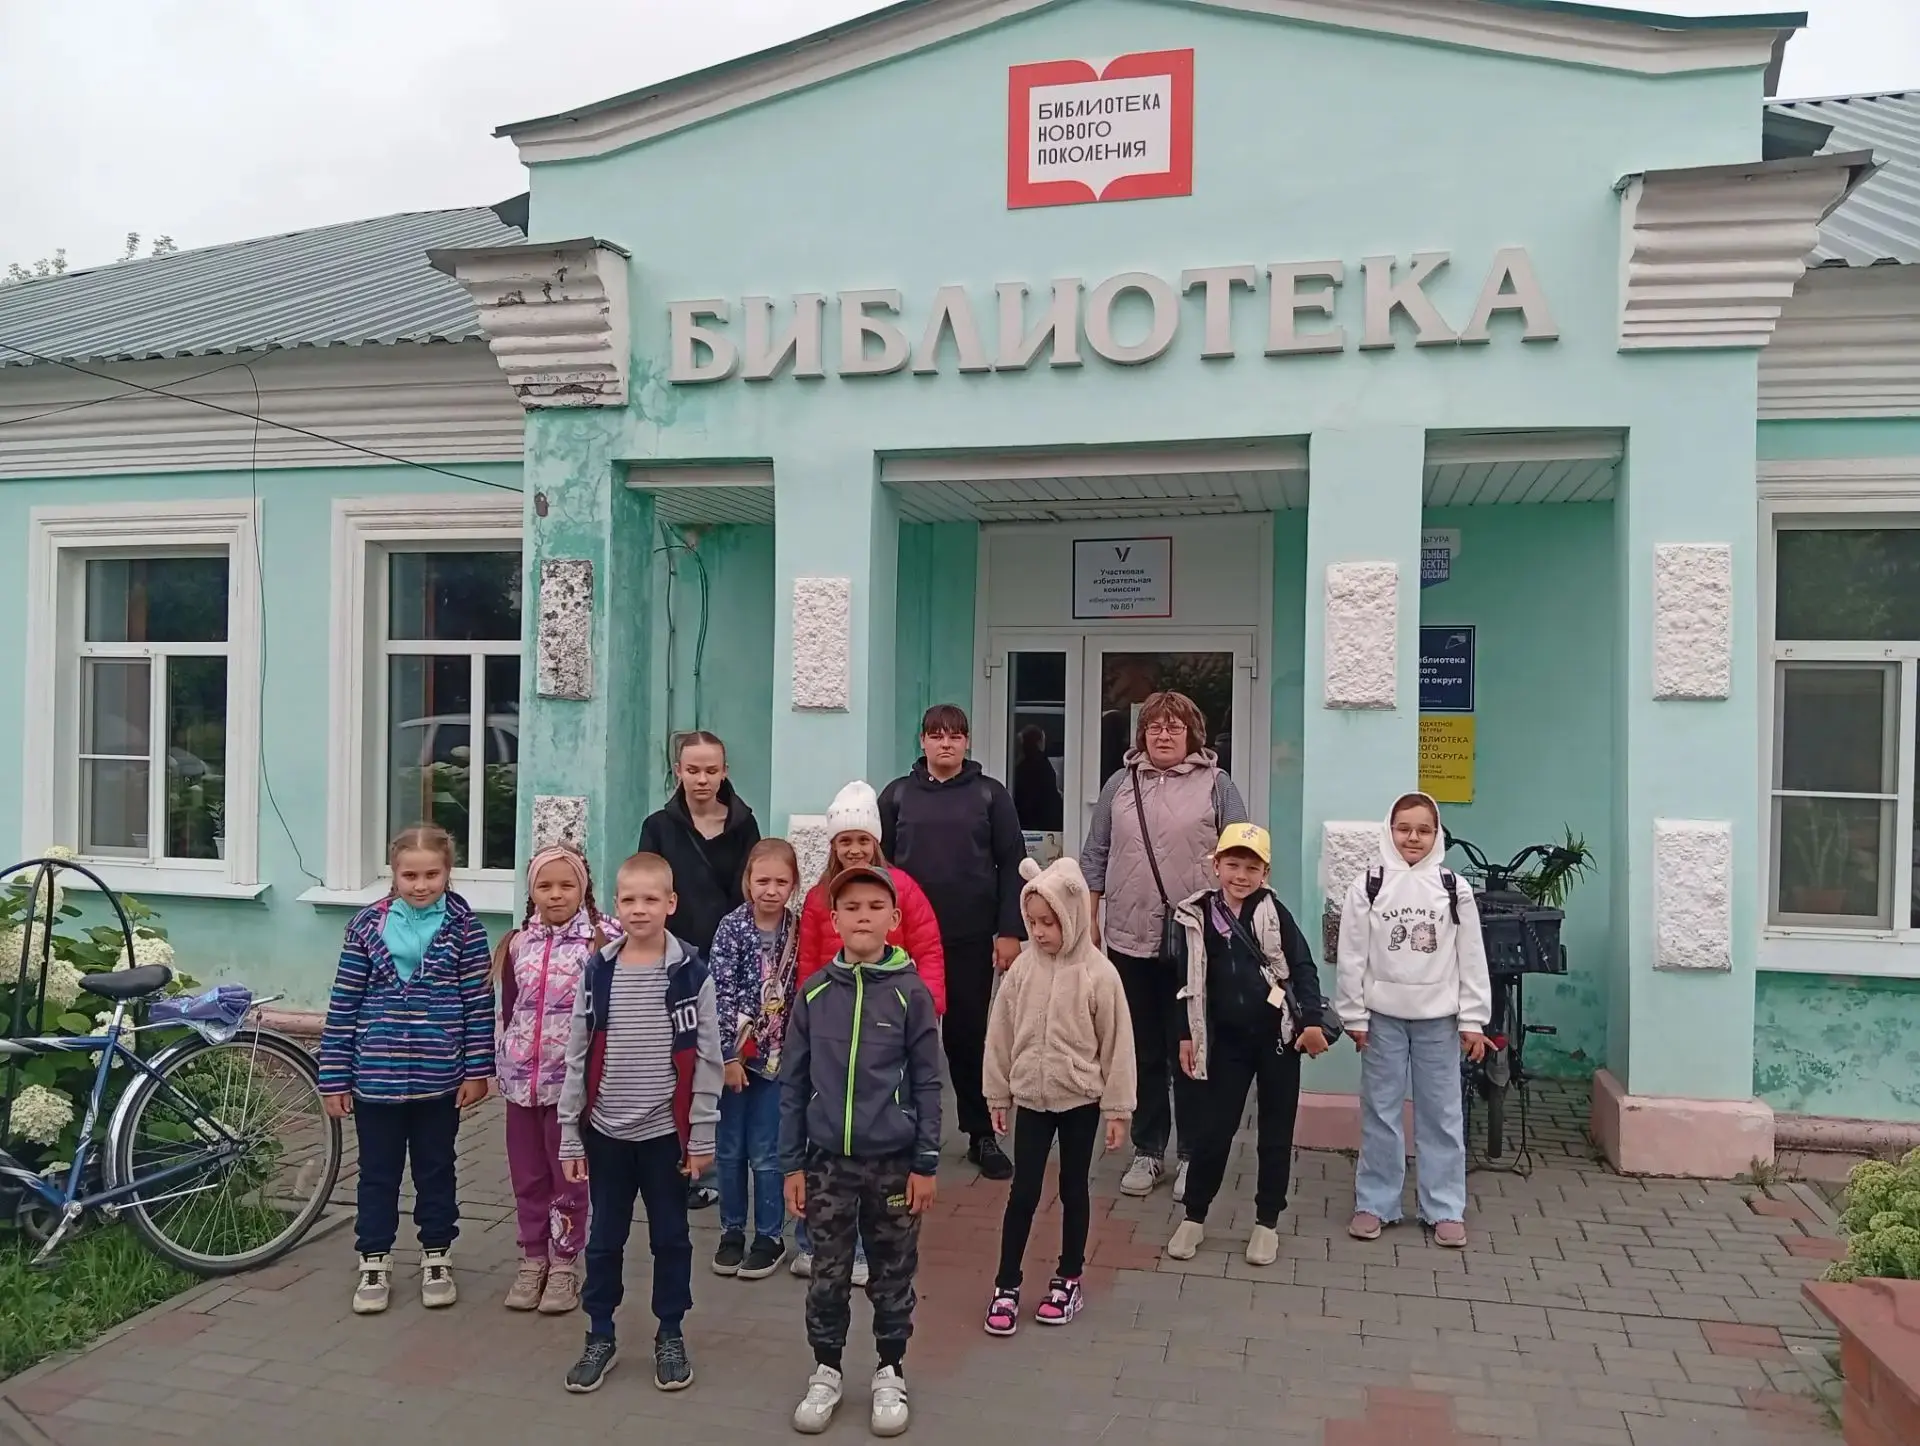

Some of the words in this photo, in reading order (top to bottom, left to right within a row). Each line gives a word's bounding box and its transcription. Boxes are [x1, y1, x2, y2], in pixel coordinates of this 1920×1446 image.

[1038, 93, 1161, 120] БИБЛИОТЕКА
[1038, 120, 1112, 143] НОВОГО
[1037, 140, 1147, 165] ПОКОЛЕНИЯ
[668, 247, 1560, 385] БИБЛИОТЕКА
[1421, 535, 1450, 544] ЬТУРА
[1420, 569, 1450, 579] ОССИИ
[1431, 677, 1463, 686] округа
